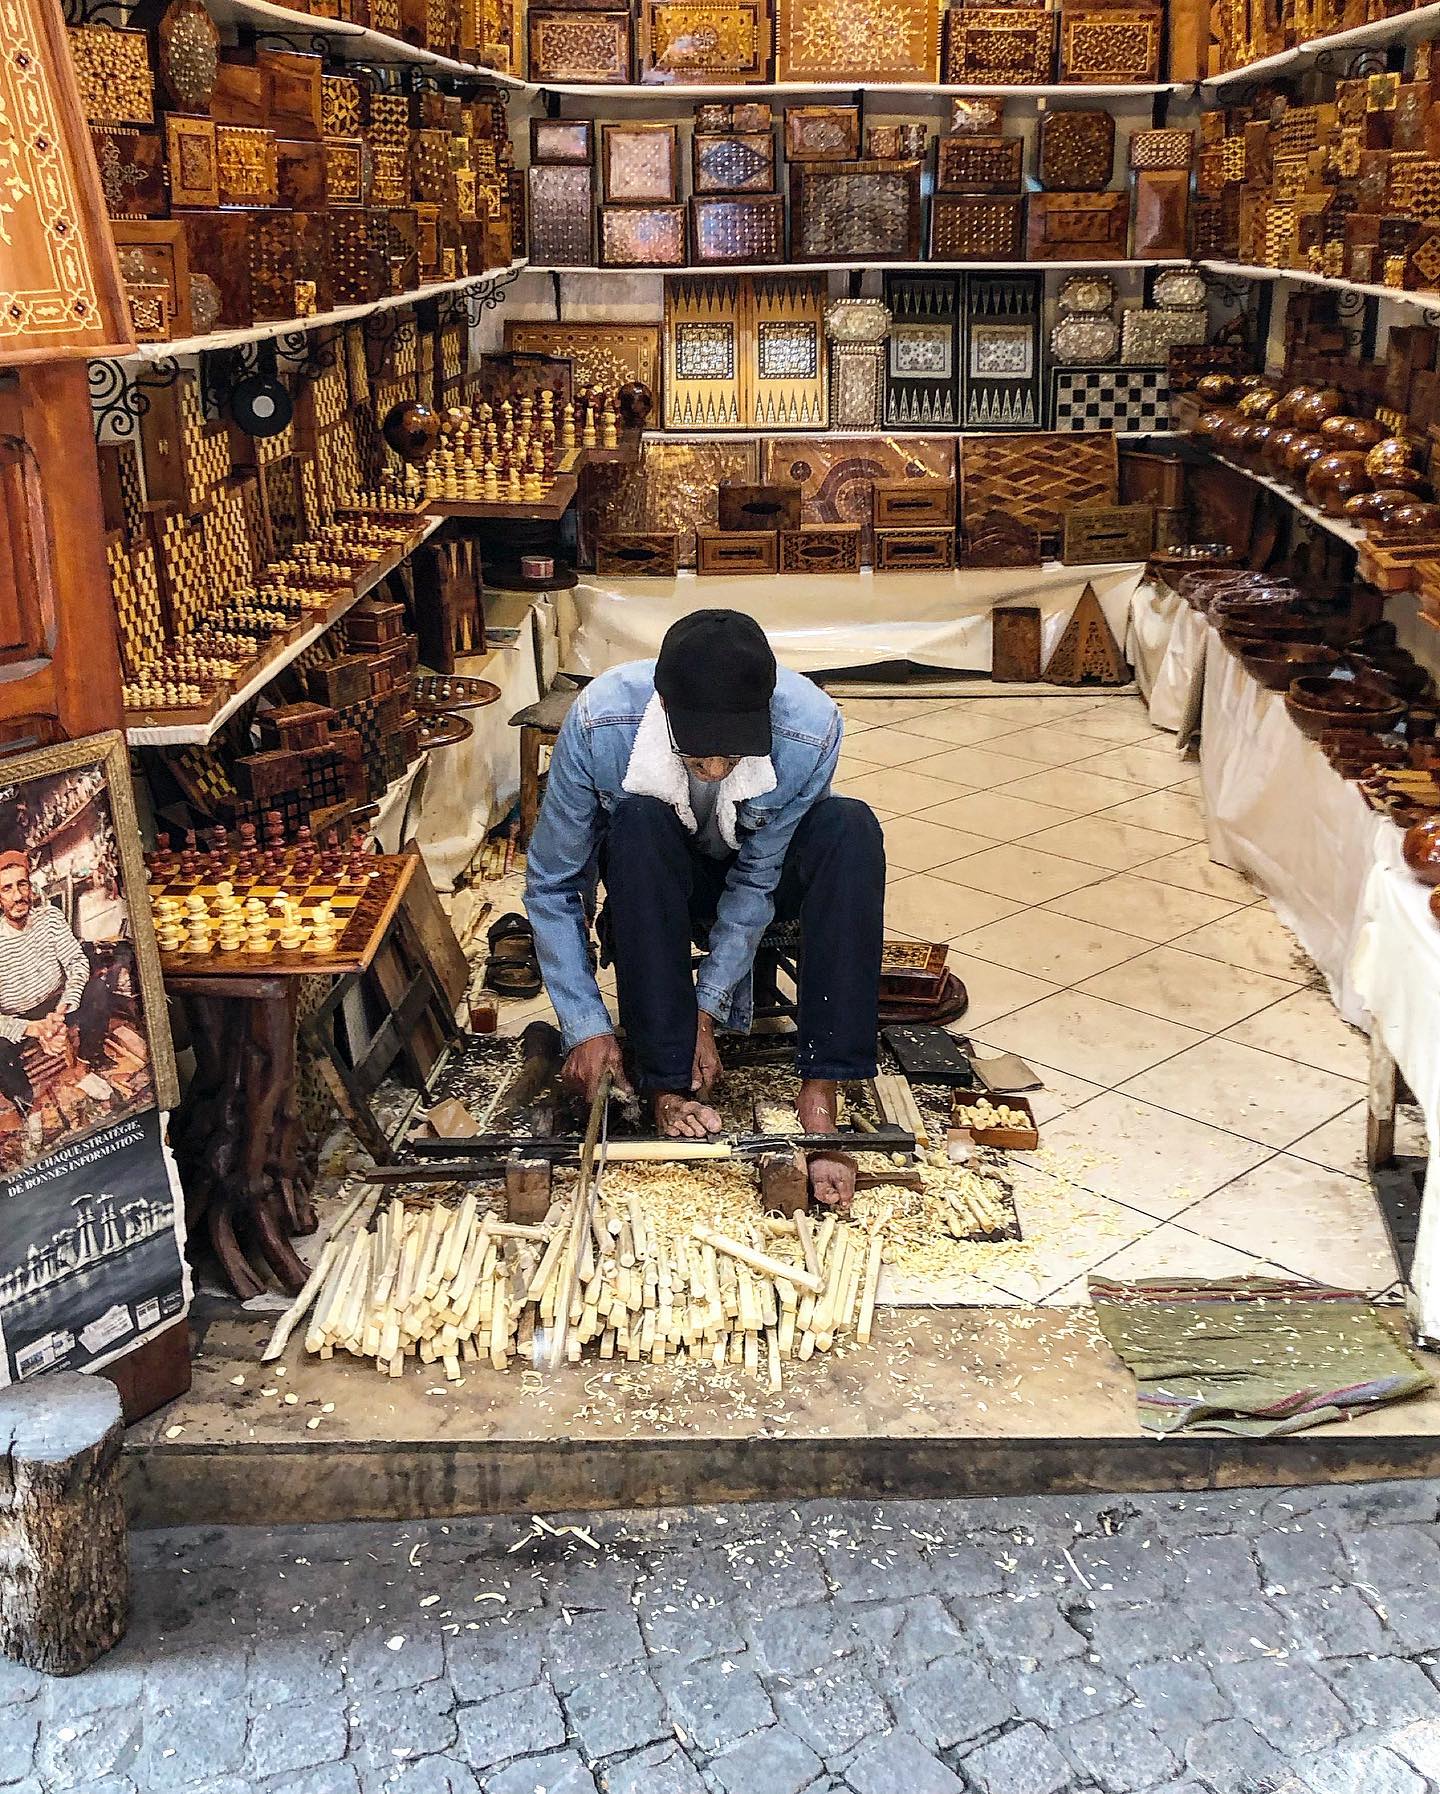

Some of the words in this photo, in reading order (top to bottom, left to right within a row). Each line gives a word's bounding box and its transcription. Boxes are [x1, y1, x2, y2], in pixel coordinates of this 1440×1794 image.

[7, 1183, 25, 1198] DE
[25, 1164, 69, 1190] BONNES
[69, 1130, 145, 1171] INFORMATIONS
[7, 1166, 36, 1184] DANS
[37, 1145, 82, 1170] CHAQUE
